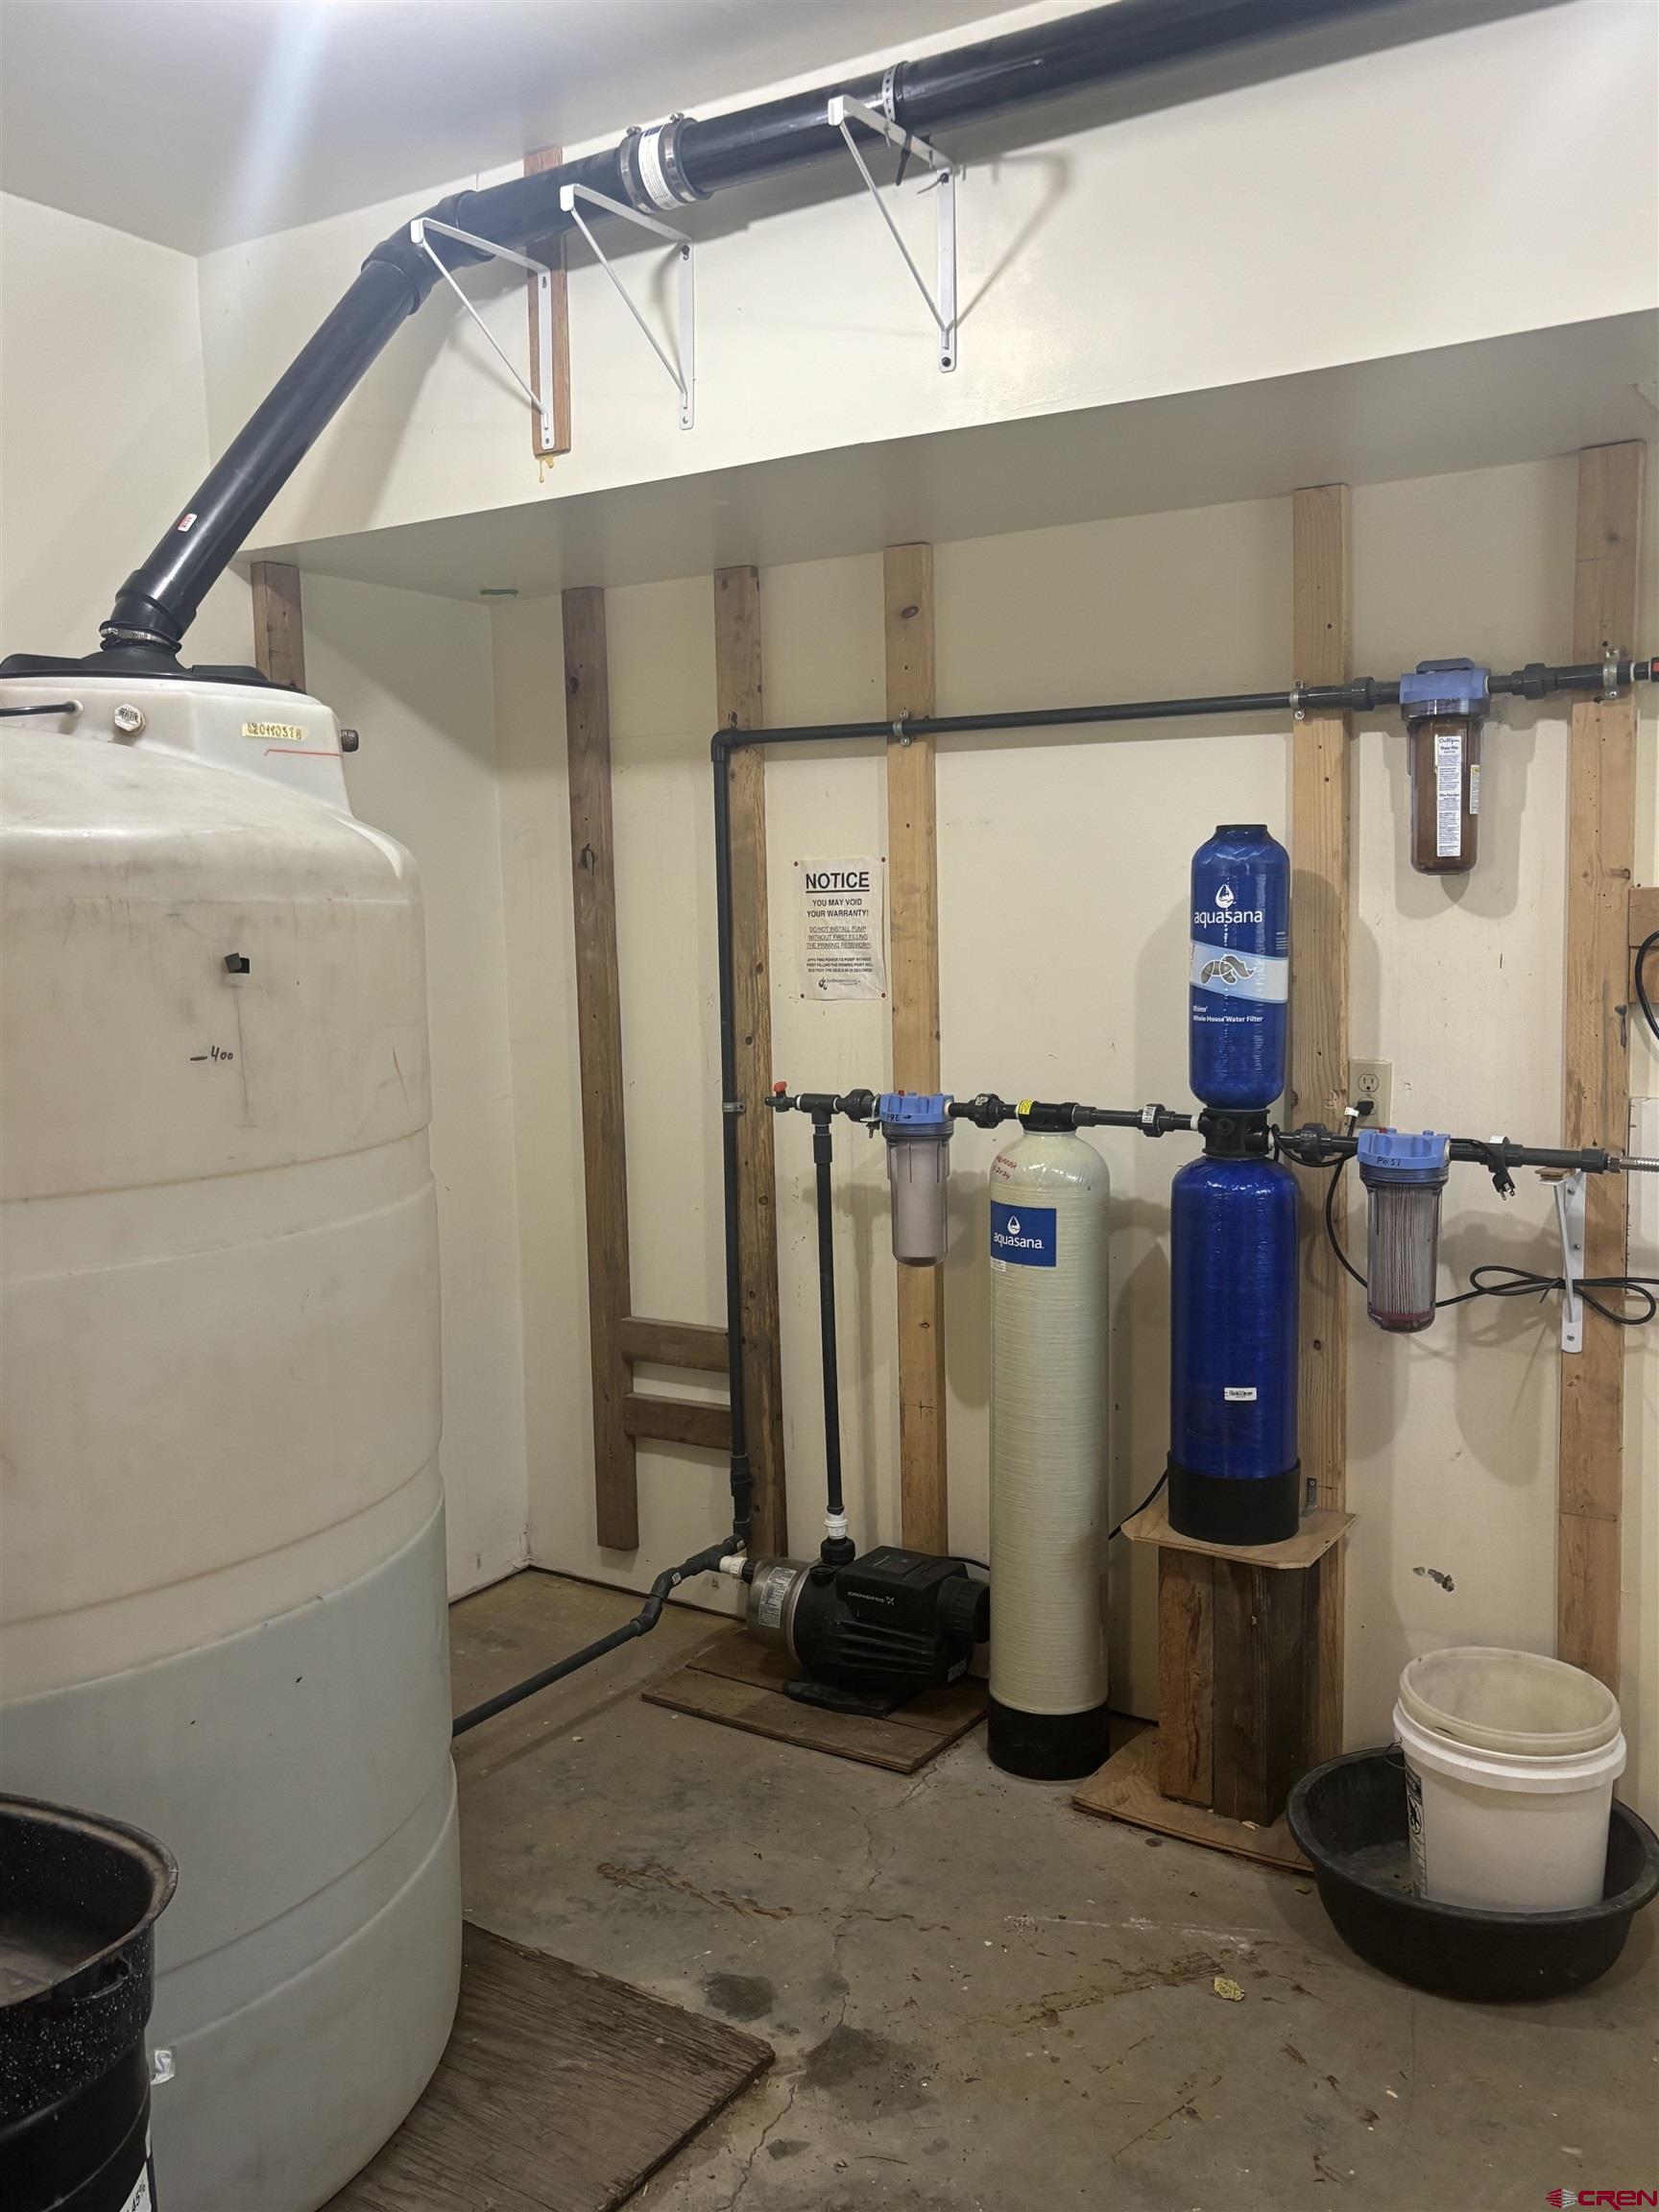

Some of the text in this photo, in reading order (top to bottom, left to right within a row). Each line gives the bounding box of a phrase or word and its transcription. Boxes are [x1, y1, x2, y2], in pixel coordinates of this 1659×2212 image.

[805, 871, 870, 889] NOTICE
[845, 898, 862, 906] VOID
[1193, 910, 1262, 928] aquasana
[210, 1045, 234, 1062] 400
[993, 1232, 1043, 1248] aquasana
